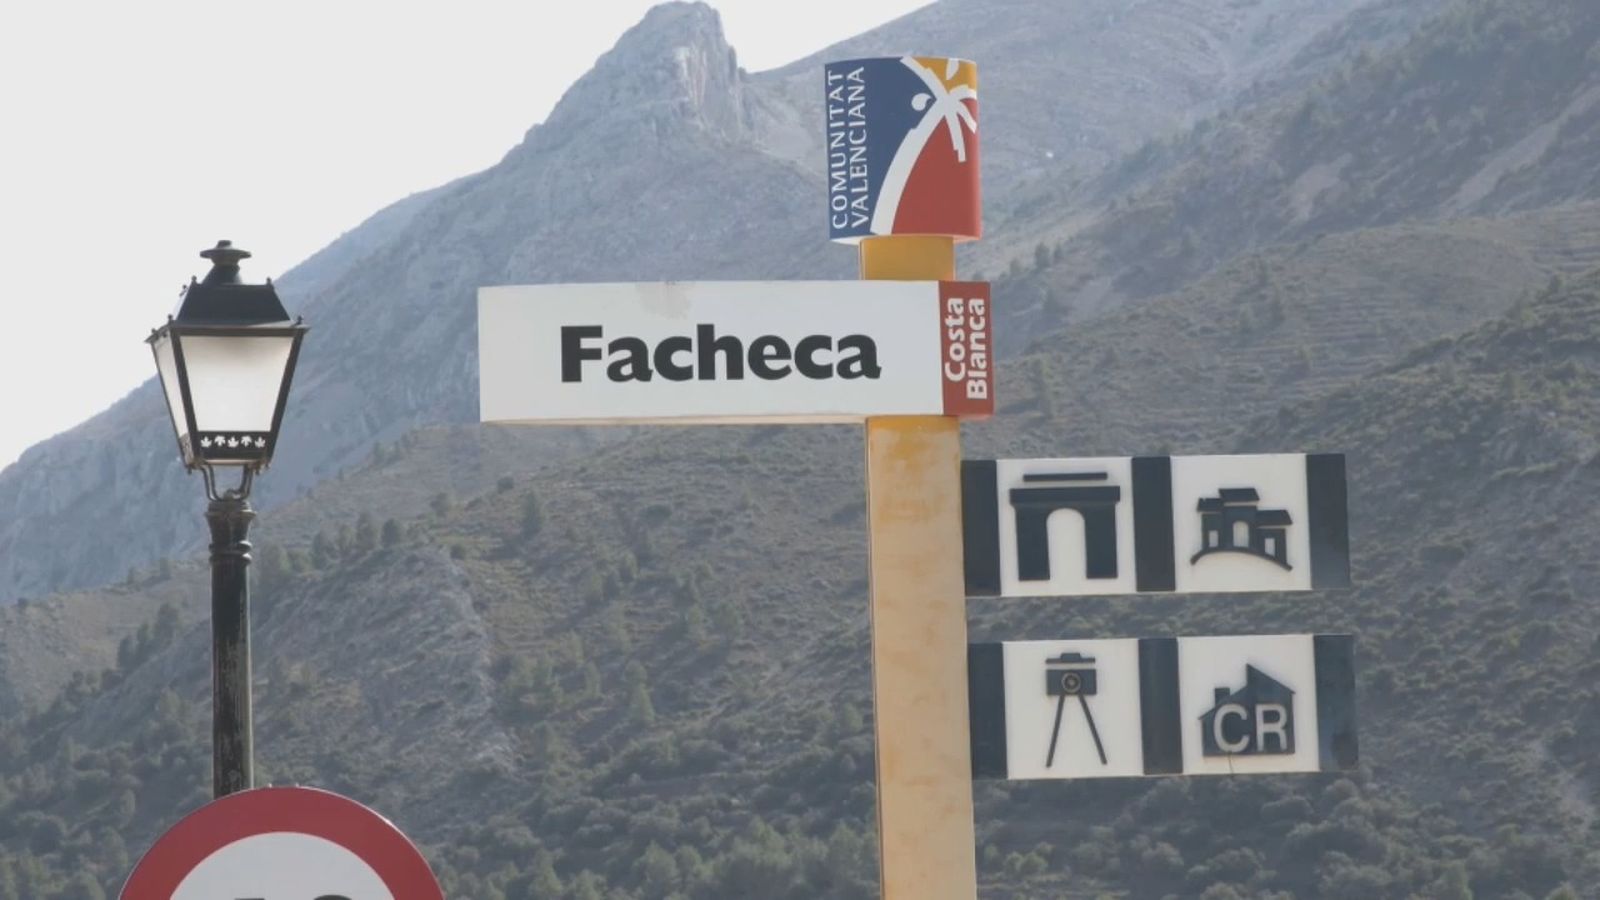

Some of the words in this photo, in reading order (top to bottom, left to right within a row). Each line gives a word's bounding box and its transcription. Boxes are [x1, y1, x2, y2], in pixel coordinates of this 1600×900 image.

[828, 70, 848, 229] COMUNITAT
[847, 66, 870, 228] VALENCIANA
[560, 323, 882, 383] Facheca
[944, 297, 965, 382] Costa
[966, 297, 988, 400] Blanca
[1213, 702, 1289, 753] CR
